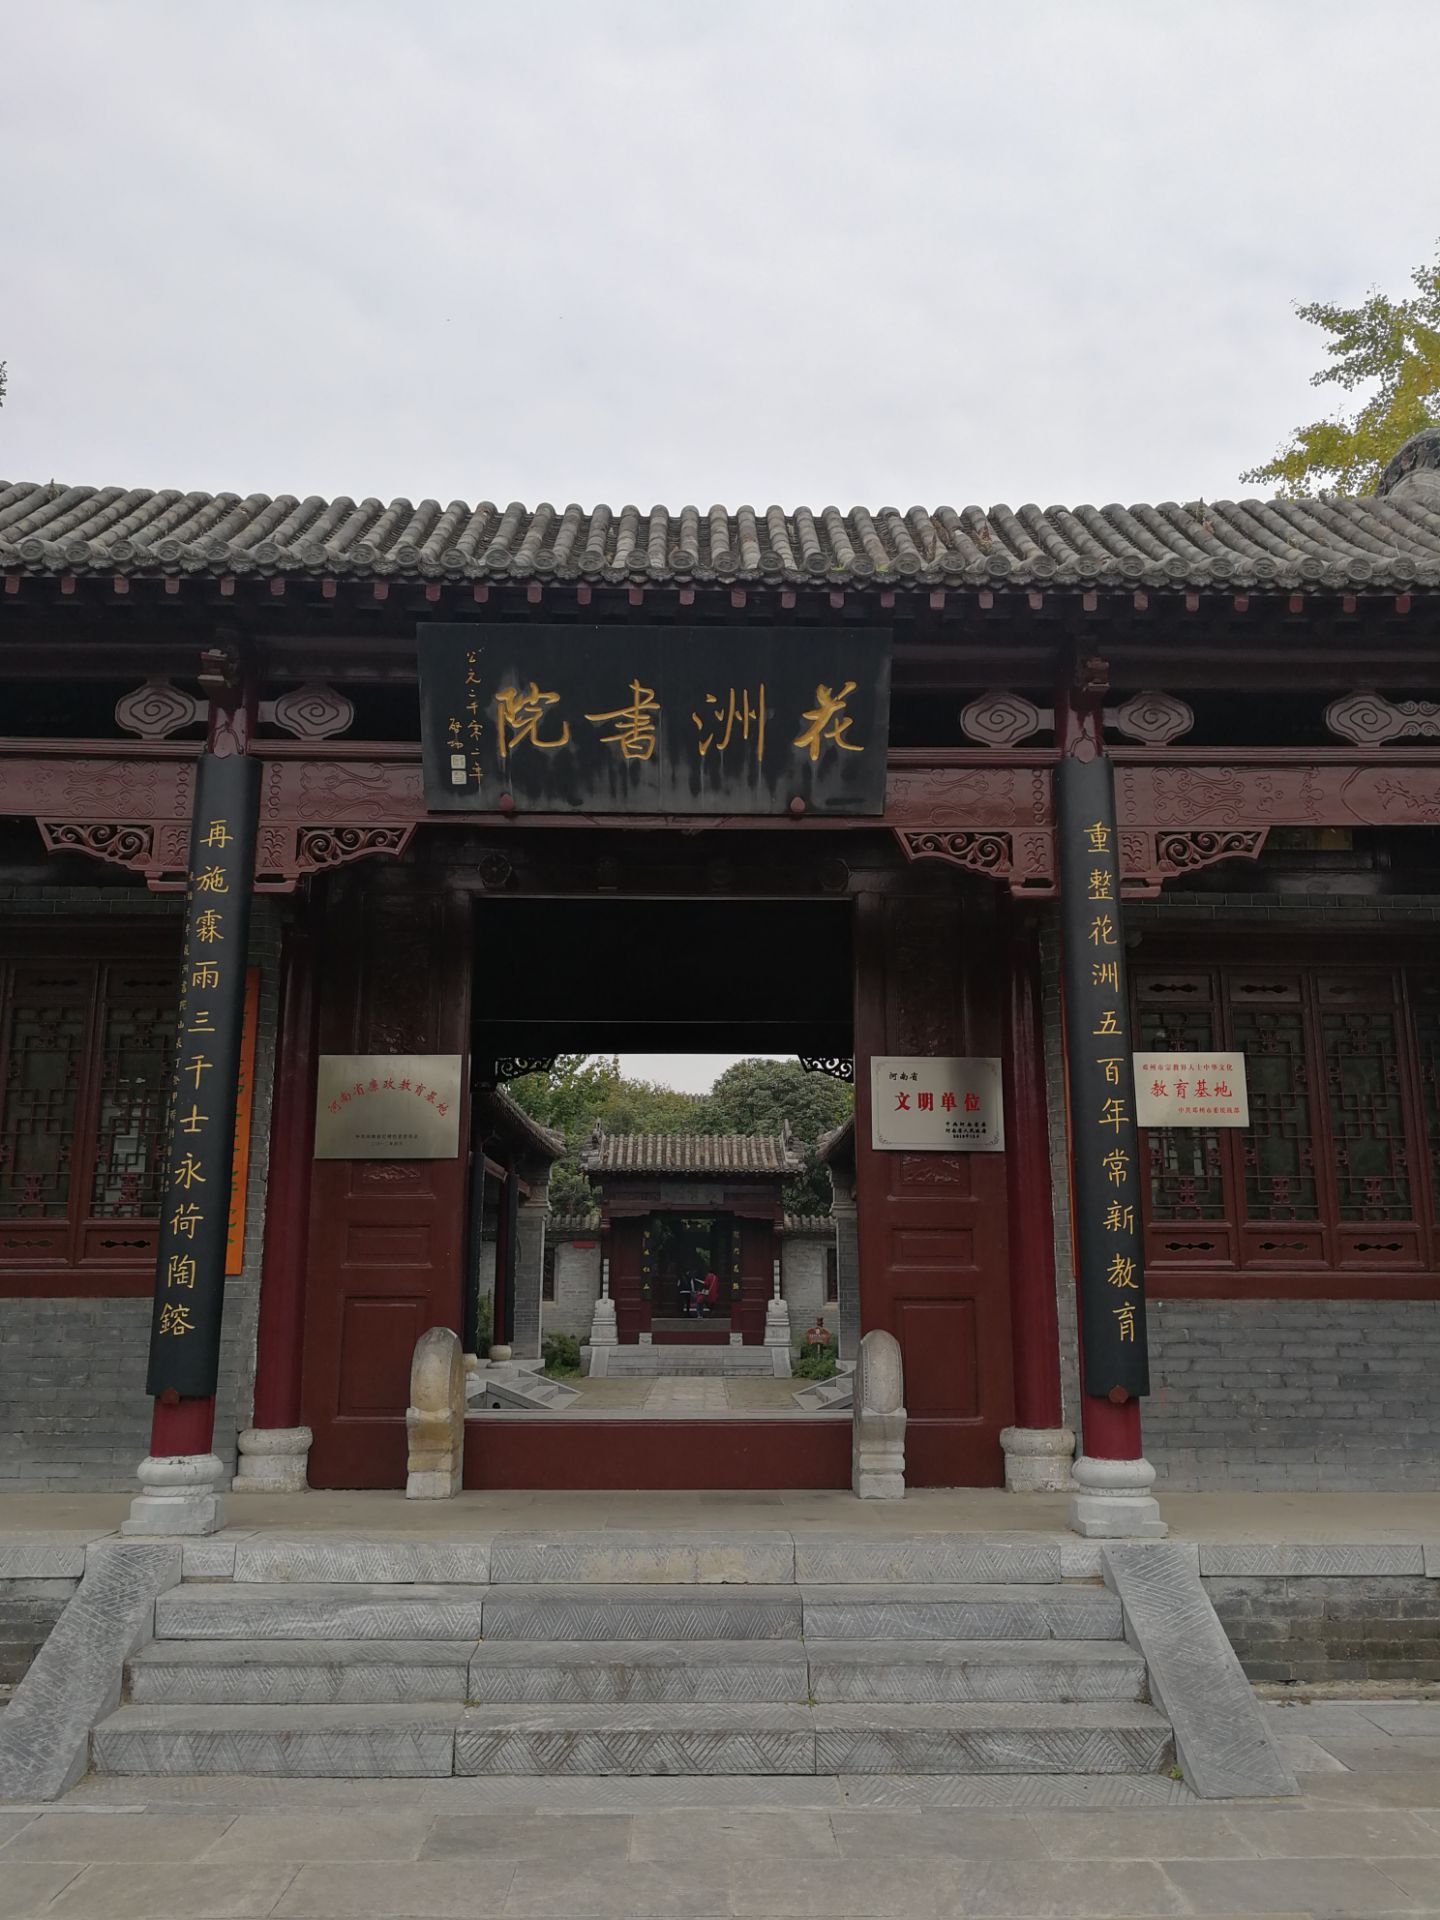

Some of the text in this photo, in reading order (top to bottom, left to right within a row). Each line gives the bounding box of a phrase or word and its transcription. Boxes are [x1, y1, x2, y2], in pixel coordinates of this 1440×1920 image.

[159, 819, 234, 1336] 再施霖雨三千士永荷陶鎔
[888, 1071, 919, 1082] 河南省
[1083, 820, 1140, 1343] 重整花洲五百年常新教育
[1150, 1078, 1233, 1099] 教育基地
[893, 1091, 981, 1113] 文明单位
